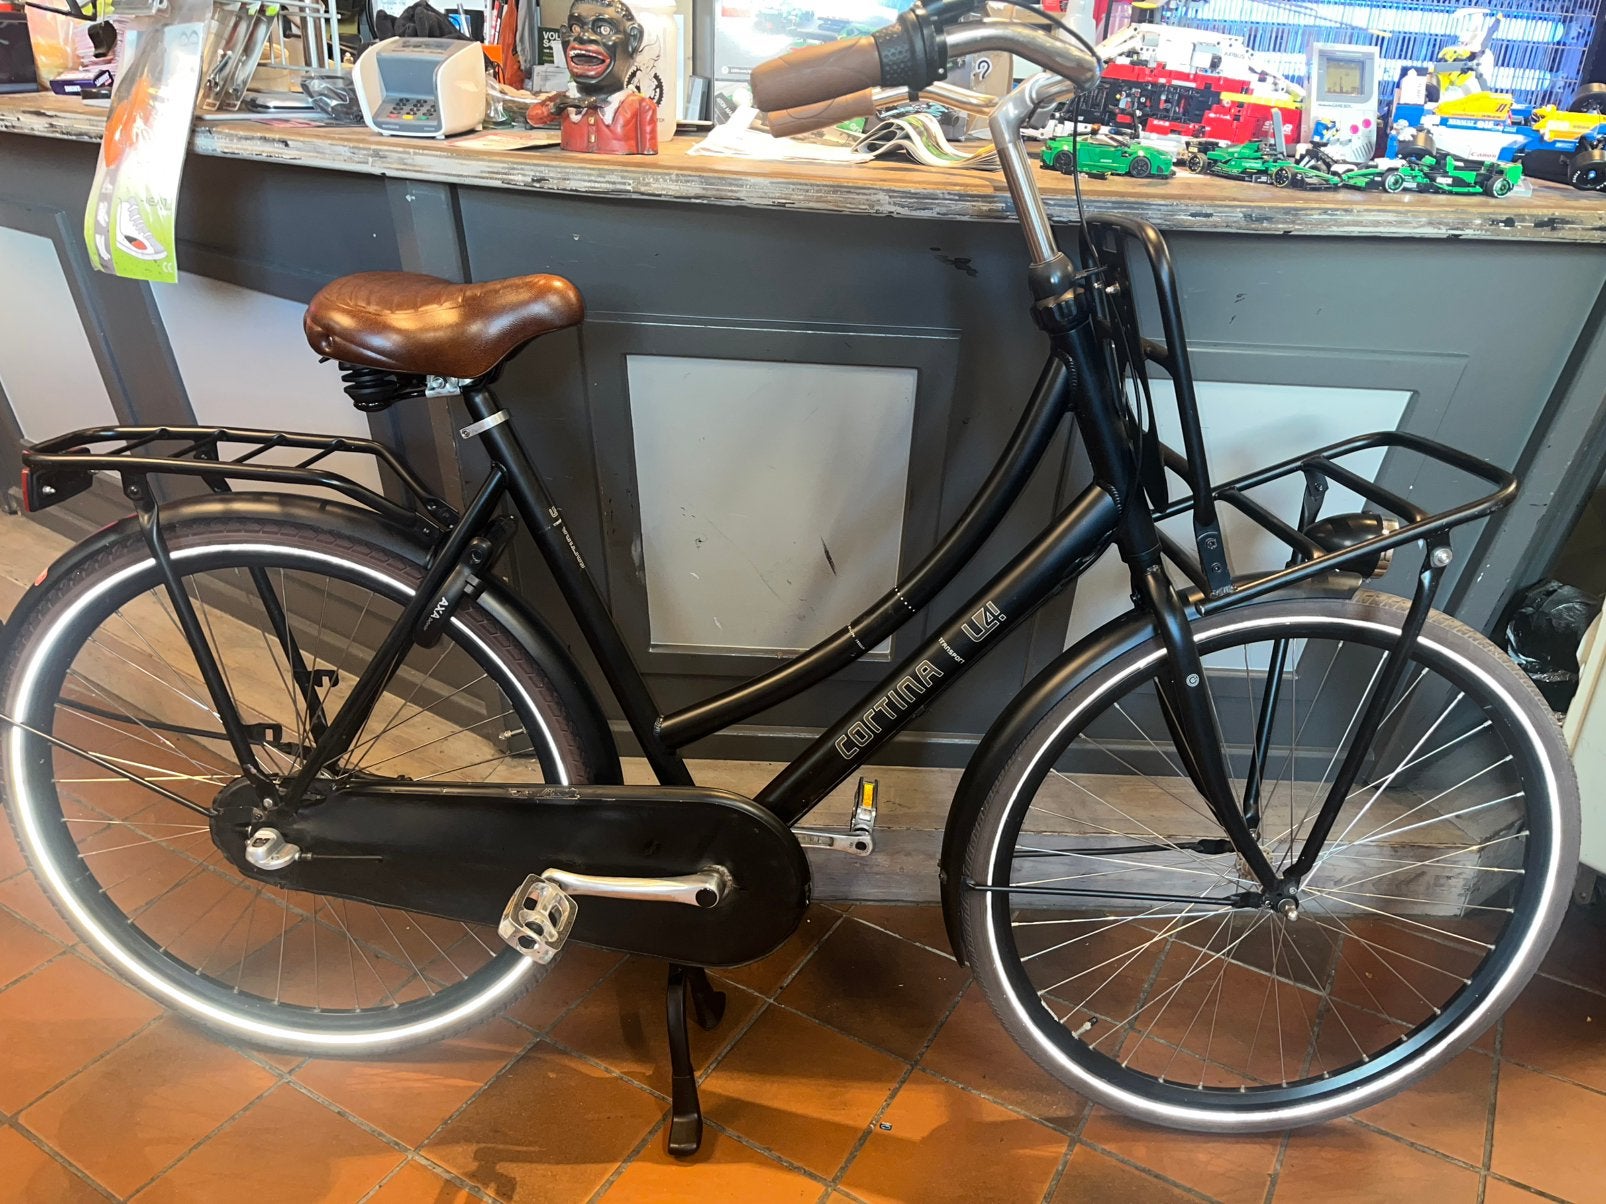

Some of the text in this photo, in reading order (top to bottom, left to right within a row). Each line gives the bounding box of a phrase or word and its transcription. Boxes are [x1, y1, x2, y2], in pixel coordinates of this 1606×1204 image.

[430, 596, 449, 619] AXA
[938, 636, 966, 665] TRANSPORT
[834, 659, 945, 760] CORTINA
